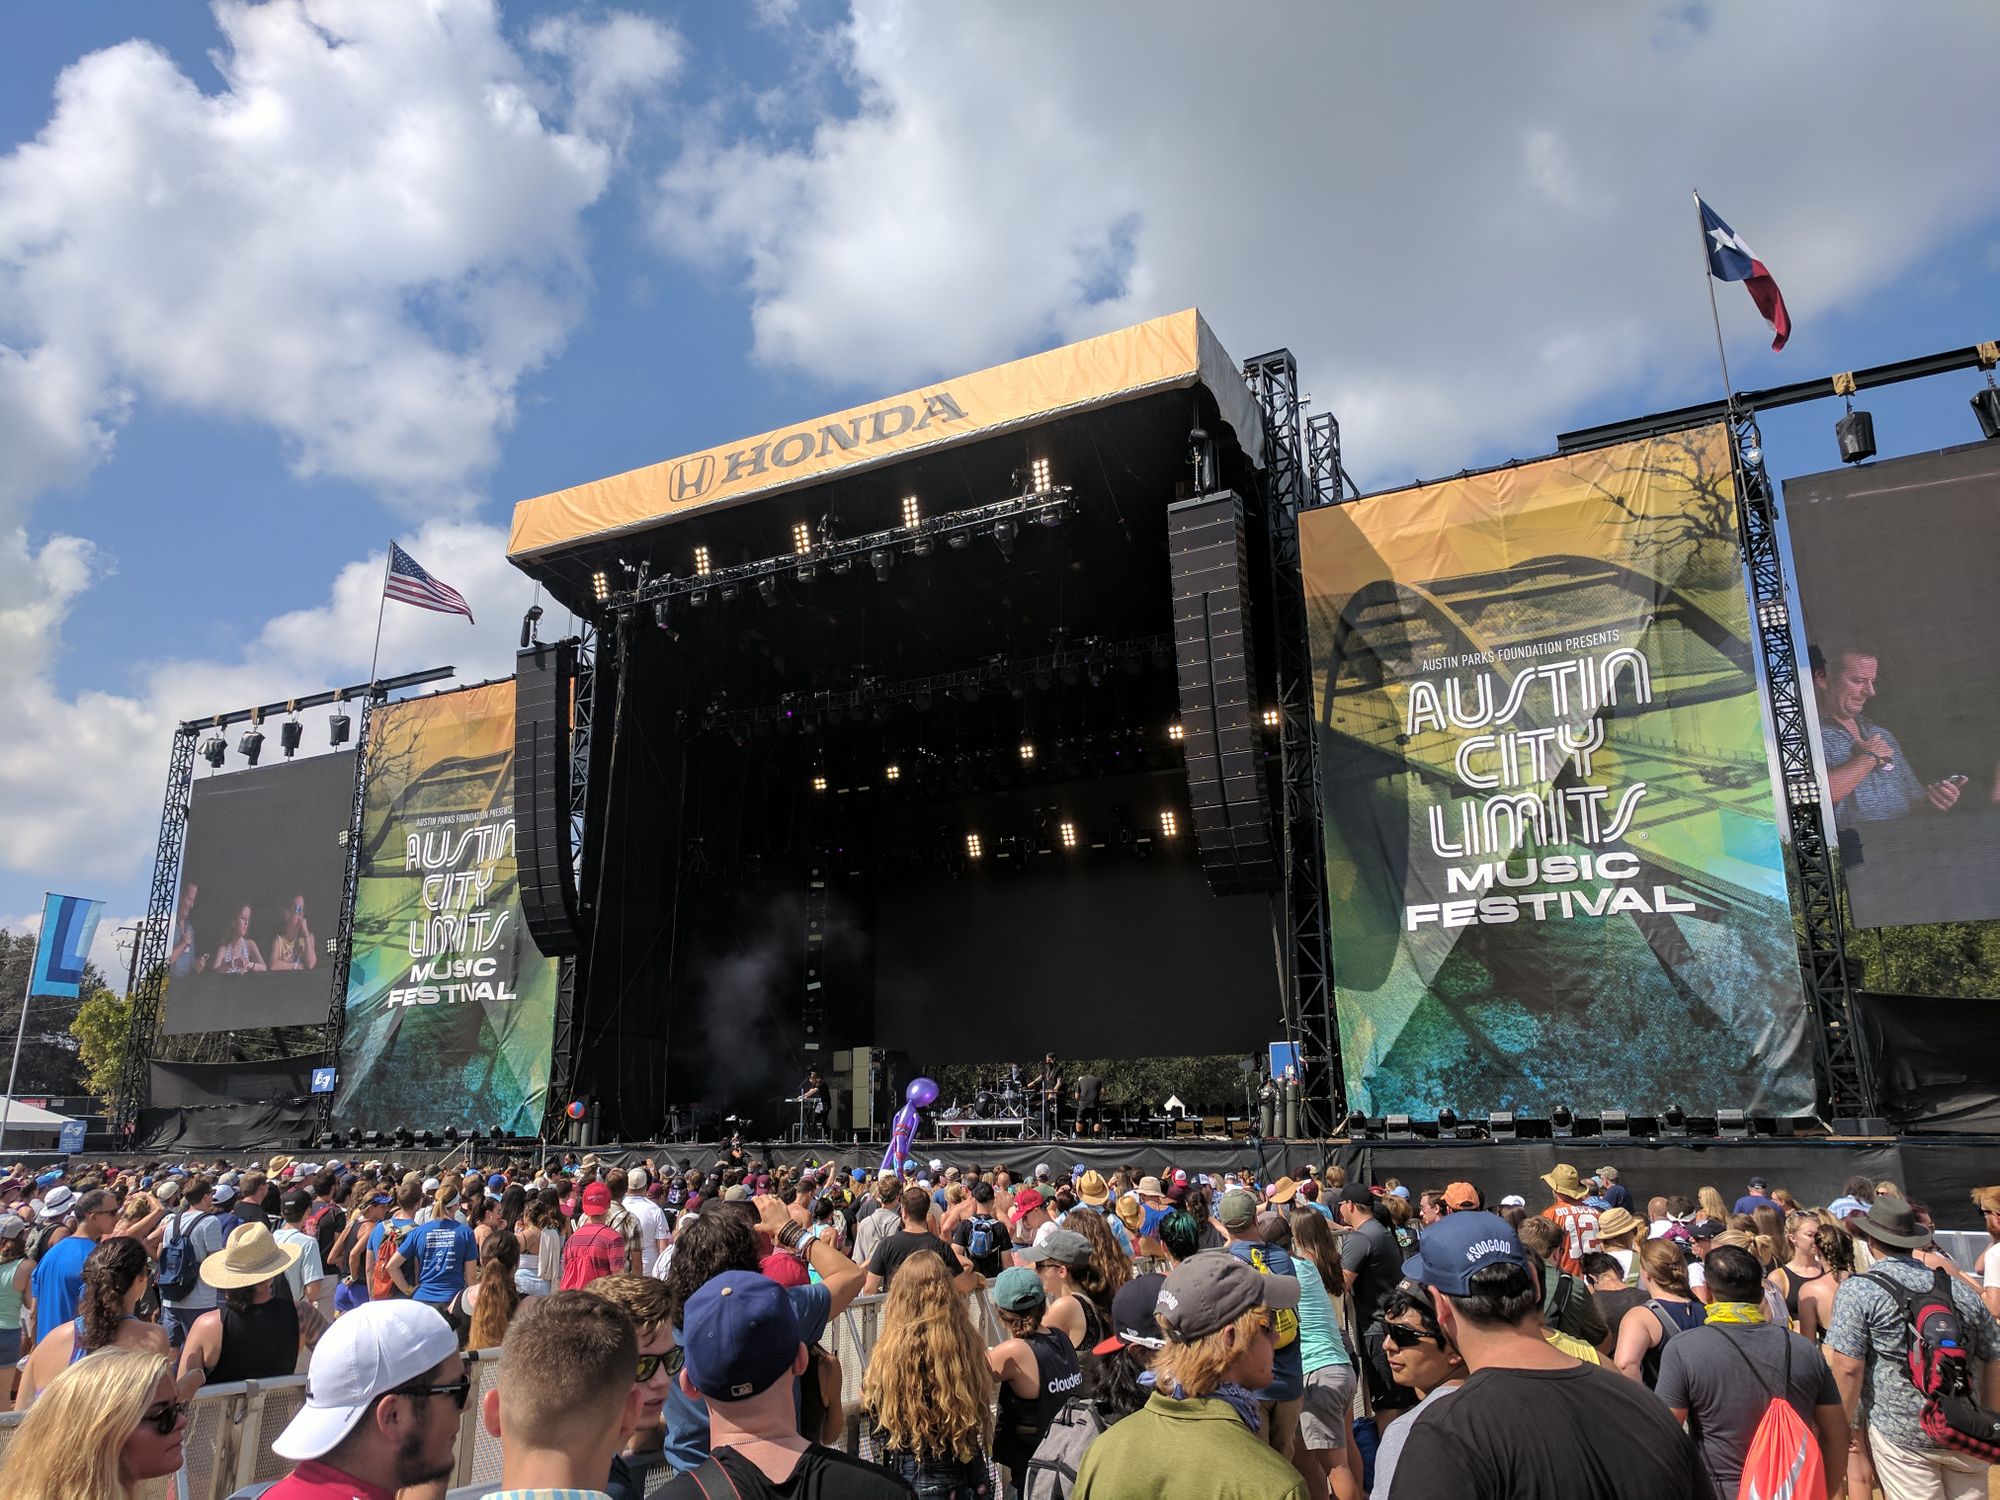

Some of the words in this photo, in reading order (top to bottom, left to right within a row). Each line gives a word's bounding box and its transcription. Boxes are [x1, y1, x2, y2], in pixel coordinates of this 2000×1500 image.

[720, 392, 969, 484] HONDA
[1422, 655, 1459, 672] AUSTIN
[1462, 651, 1495, 666] PARKS
[1498, 640, 1562, 661] FOUNDATION
[1565, 629, 1620, 651] PRESENTS
[1406, 647, 1652, 737] AUSTIN
[1454, 717, 1606, 790] CITY
[415, 816, 437, 827] AUSTIN
[437, 814, 456, 825] PARKS
[456, 810, 489, 823] FOUNDATION
[489, 805, 513, 818] PRESENTS
[1428, 781, 1648, 860] LIMITS
[405, 818, 516, 872] AUSTIN
[422, 866, 496, 912] CITY
[1447, 852, 1641, 894] MUSIC
[1406, 885, 1697, 932] FESTIVAL
[408, 910, 510, 959] LIMITS
[409, 957, 498, 983] MUSIC
[387, 980, 518, 1009] FESTIVAL
[1564, 1213, 1602, 1260] 12
